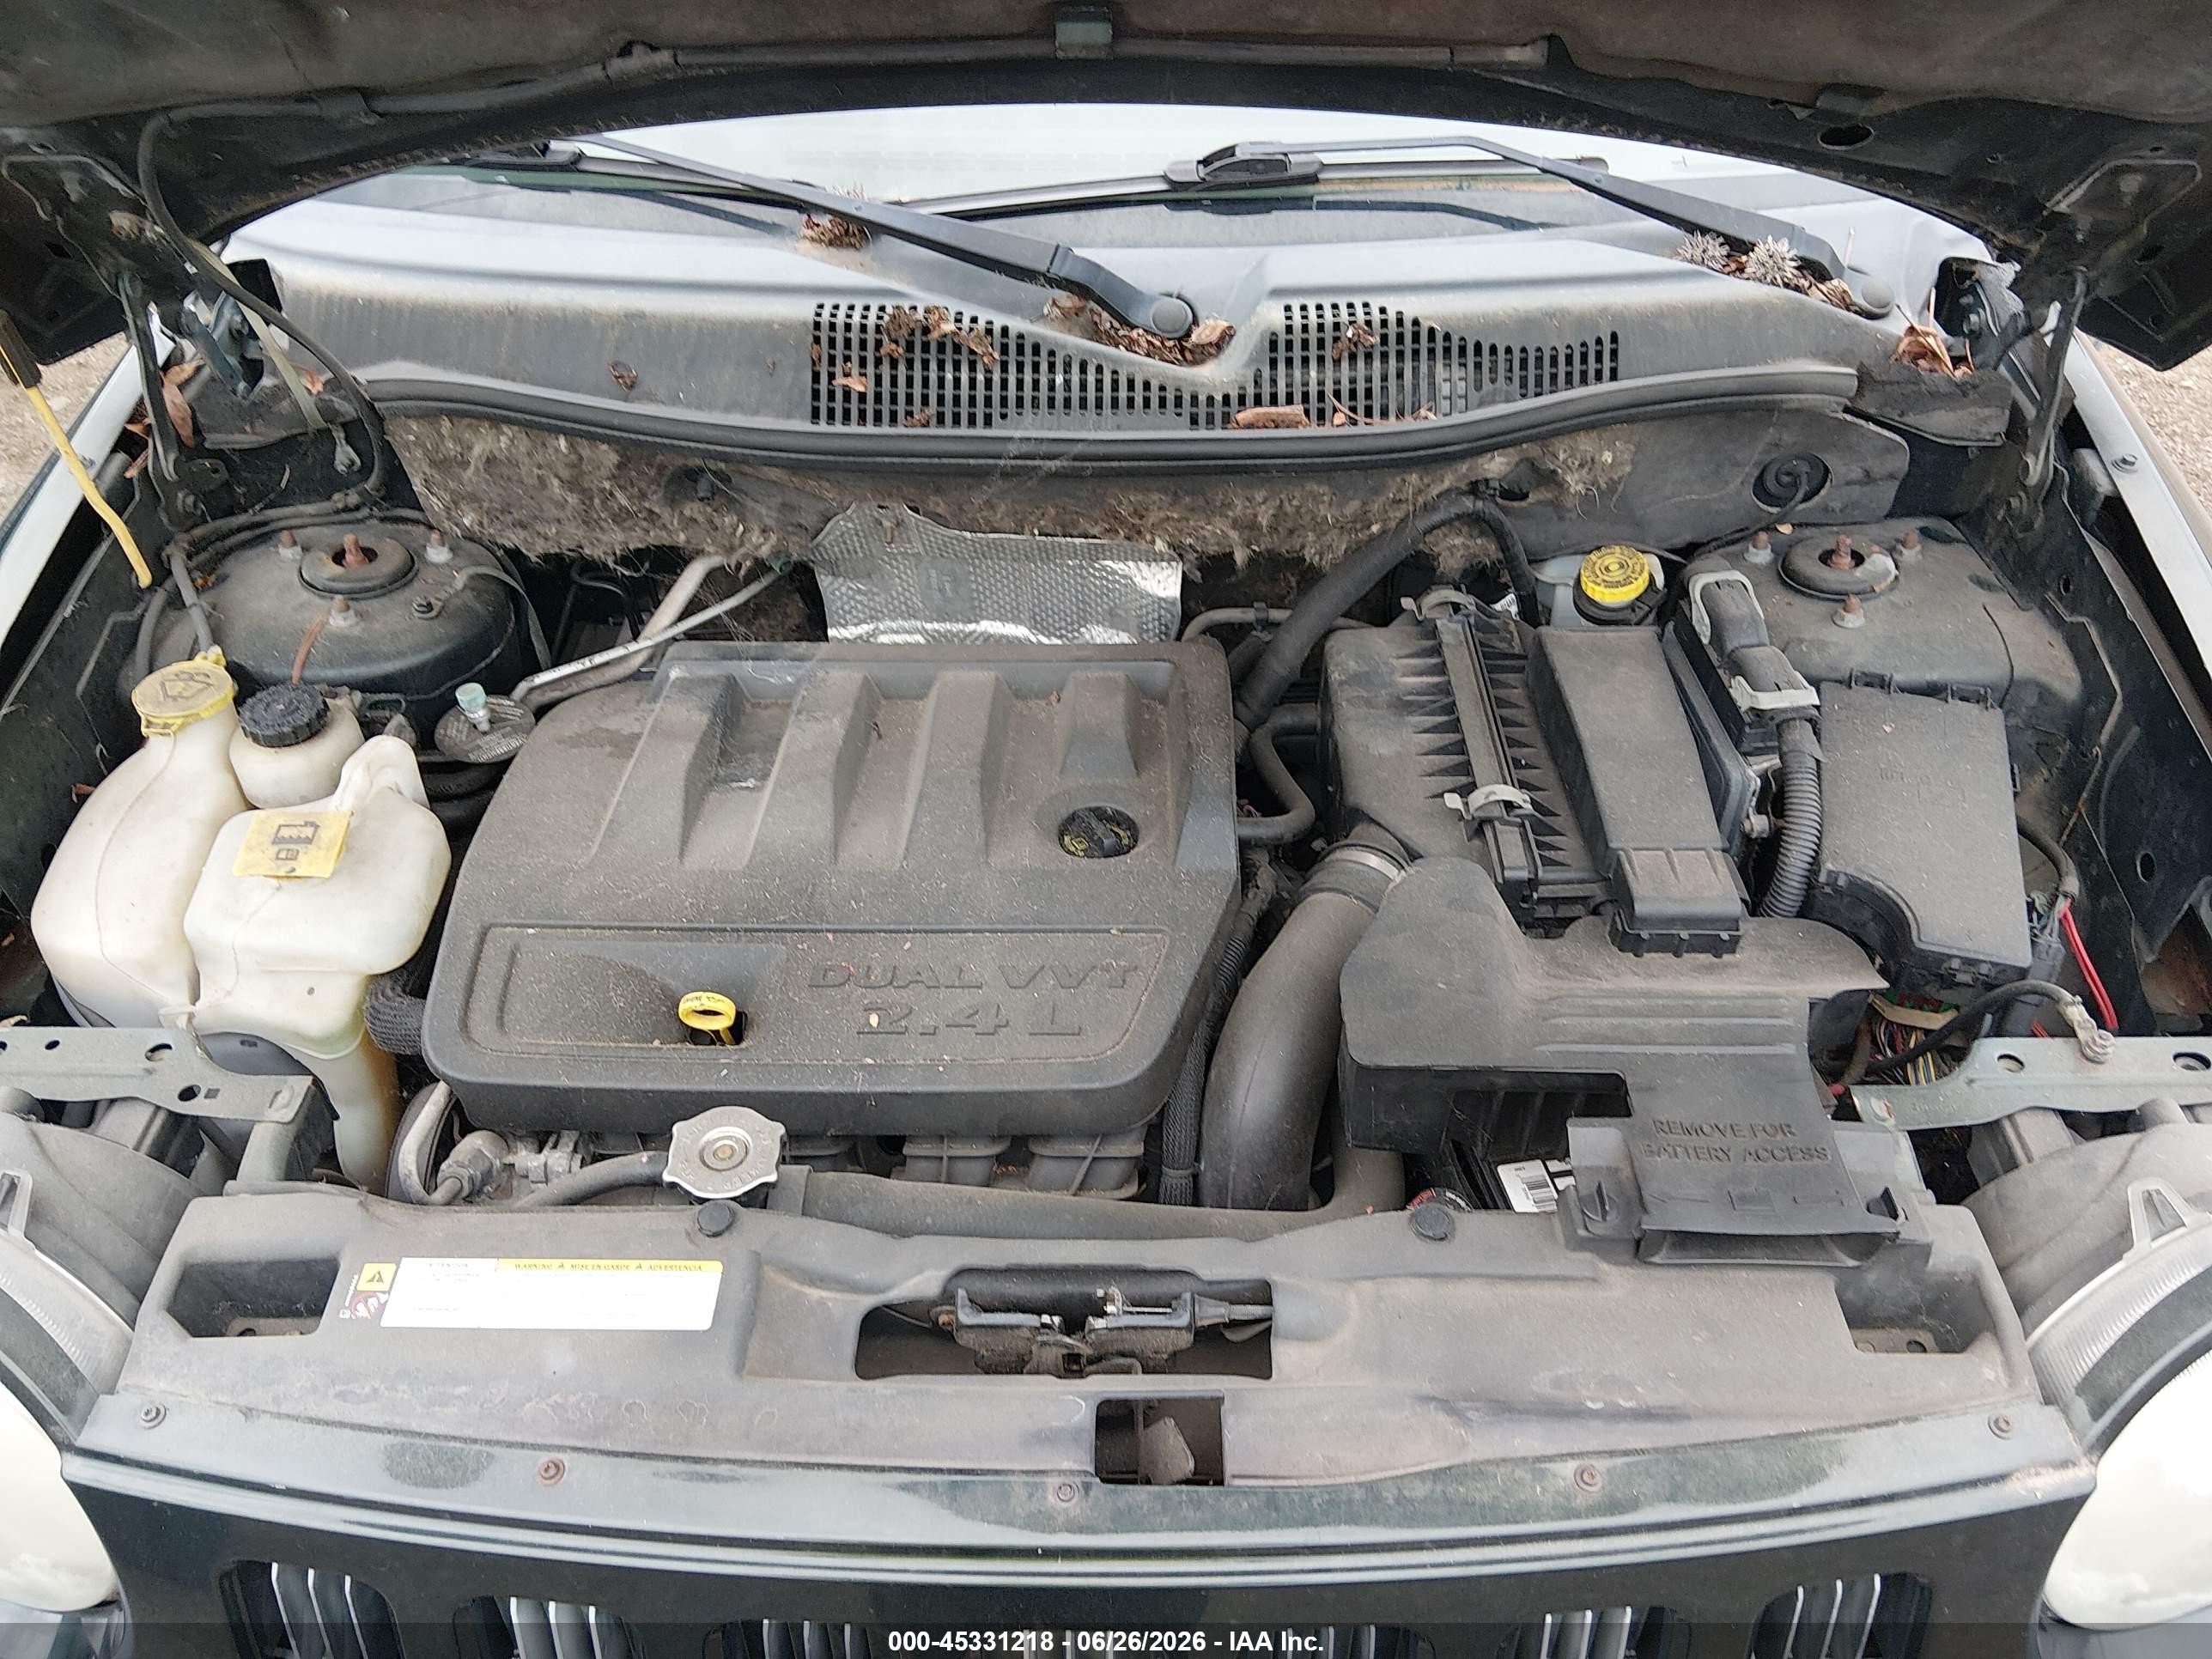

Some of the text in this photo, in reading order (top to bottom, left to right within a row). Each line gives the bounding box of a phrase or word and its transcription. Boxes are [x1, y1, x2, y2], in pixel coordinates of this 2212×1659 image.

[809, 963, 1139, 990] DUAL VVT
[1653, 1119, 1796, 1139] REMOVE FOR
[1642, 1144, 1829, 1163] BATTERY ACCESS
